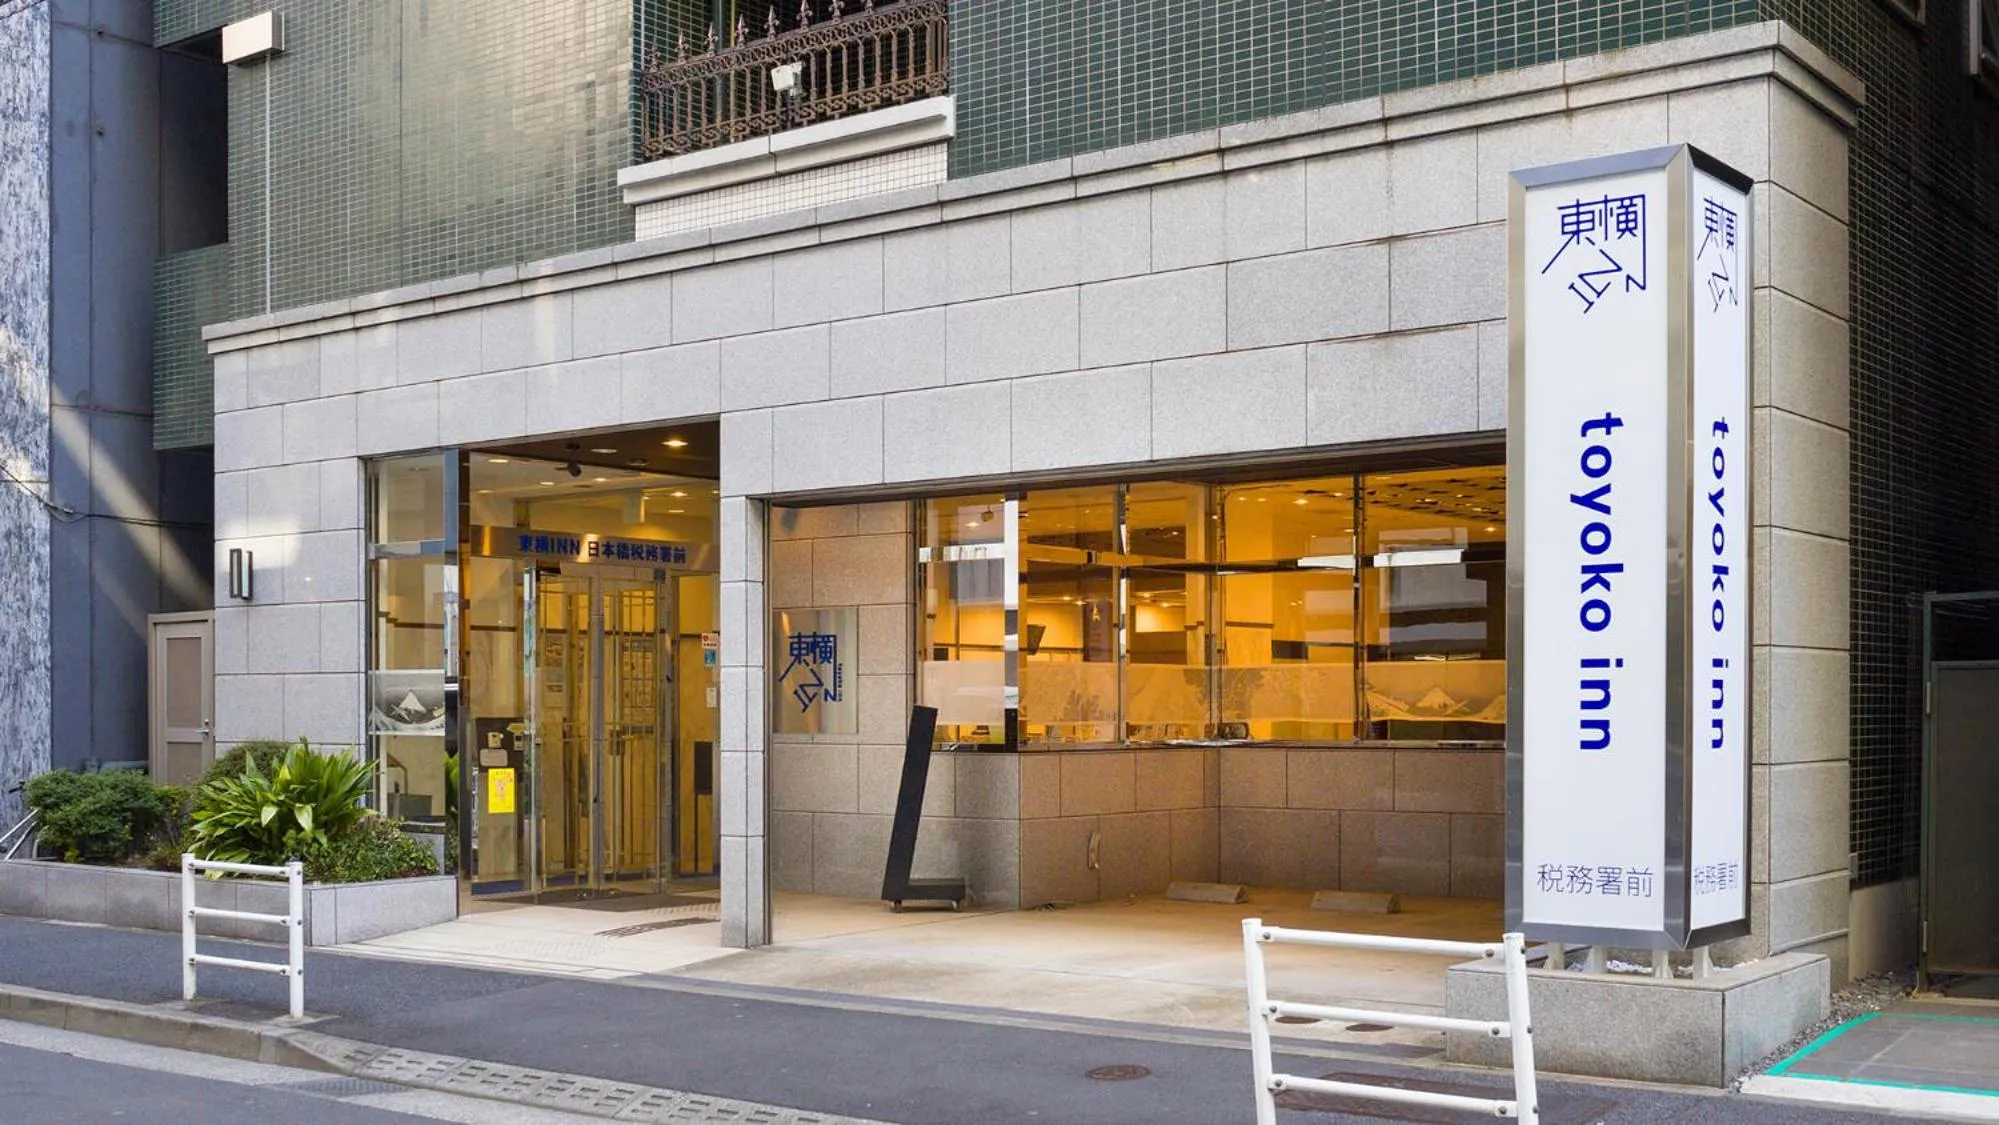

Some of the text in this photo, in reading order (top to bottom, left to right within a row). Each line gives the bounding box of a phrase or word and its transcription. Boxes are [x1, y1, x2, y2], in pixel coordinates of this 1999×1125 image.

[519, 534, 687, 563] 東横INN 日本橋税務署前
[1569, 412, 1624, 750] toyoko inn
[1708, 416, 1730, 749] toyoko inn
[1537, 863, 1654, 898] 税務署前
[1694, 862, 1739, 896] 税務署前
